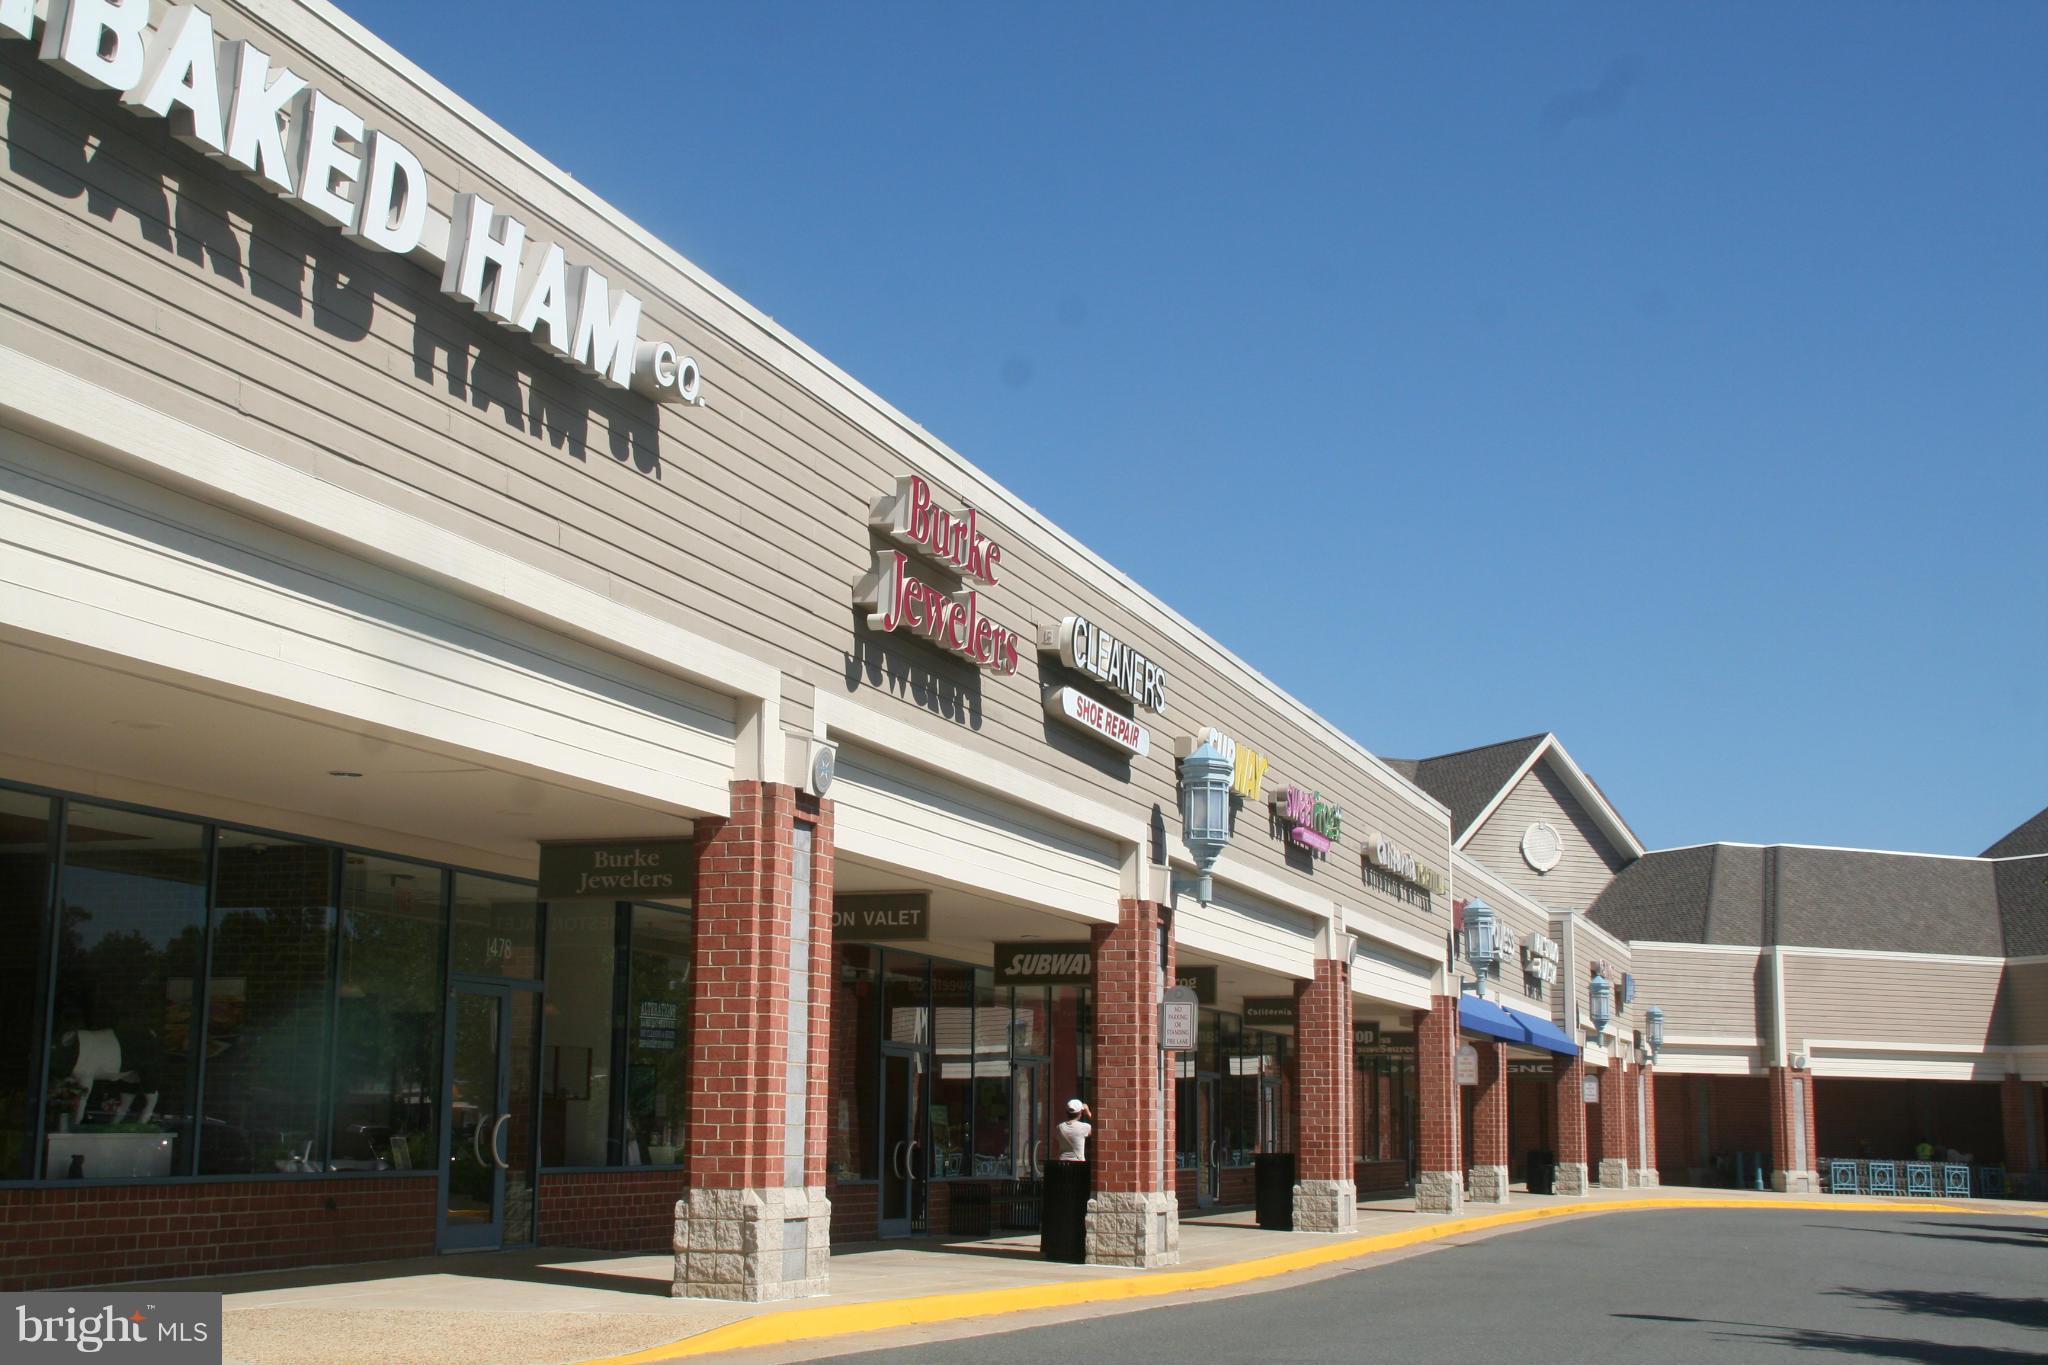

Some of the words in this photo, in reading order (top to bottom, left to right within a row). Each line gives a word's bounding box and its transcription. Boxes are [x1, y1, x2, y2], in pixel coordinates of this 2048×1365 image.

[0, 0, 428, 254] BAKED
[458, 192, 642, 390] HAM
[906, 474, 1001, 587] Burke
[883, 549, 1019, 677] Jewelers
[1071, 616, 1166, 714] CLEANERS
[1076, 695, 1104, 729] SHOE
[1105, 712, 1141, 748] REPAIR
[576, 871, 673, 893] Jewelers
[593, 849, 660, 869] Burke
[863, 909, 921, 926] VALET
[1247, 1008, 1292, 1017] California
